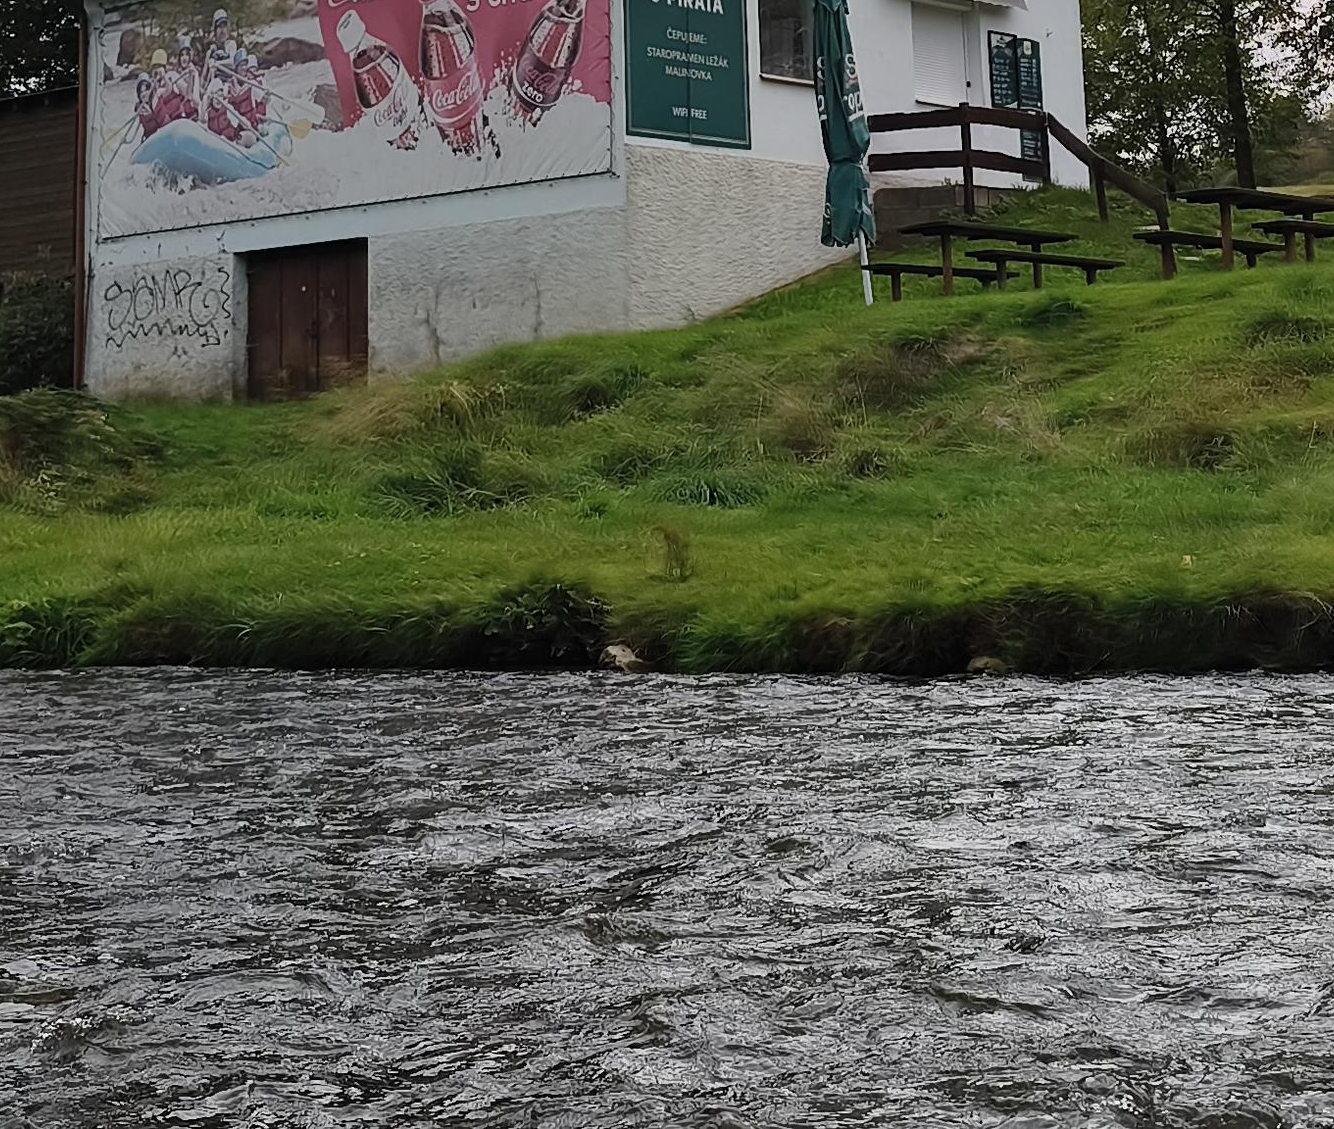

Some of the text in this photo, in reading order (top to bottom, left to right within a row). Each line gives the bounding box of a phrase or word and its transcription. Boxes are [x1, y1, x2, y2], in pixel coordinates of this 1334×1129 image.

[646, 46, 729, 68] STAROPRAMEN LEŽÁK
[665, 65, 713, 81] MALINOVKA
[522, 80, 544, 104] zero
[690, 108, 707, 120] FREE
